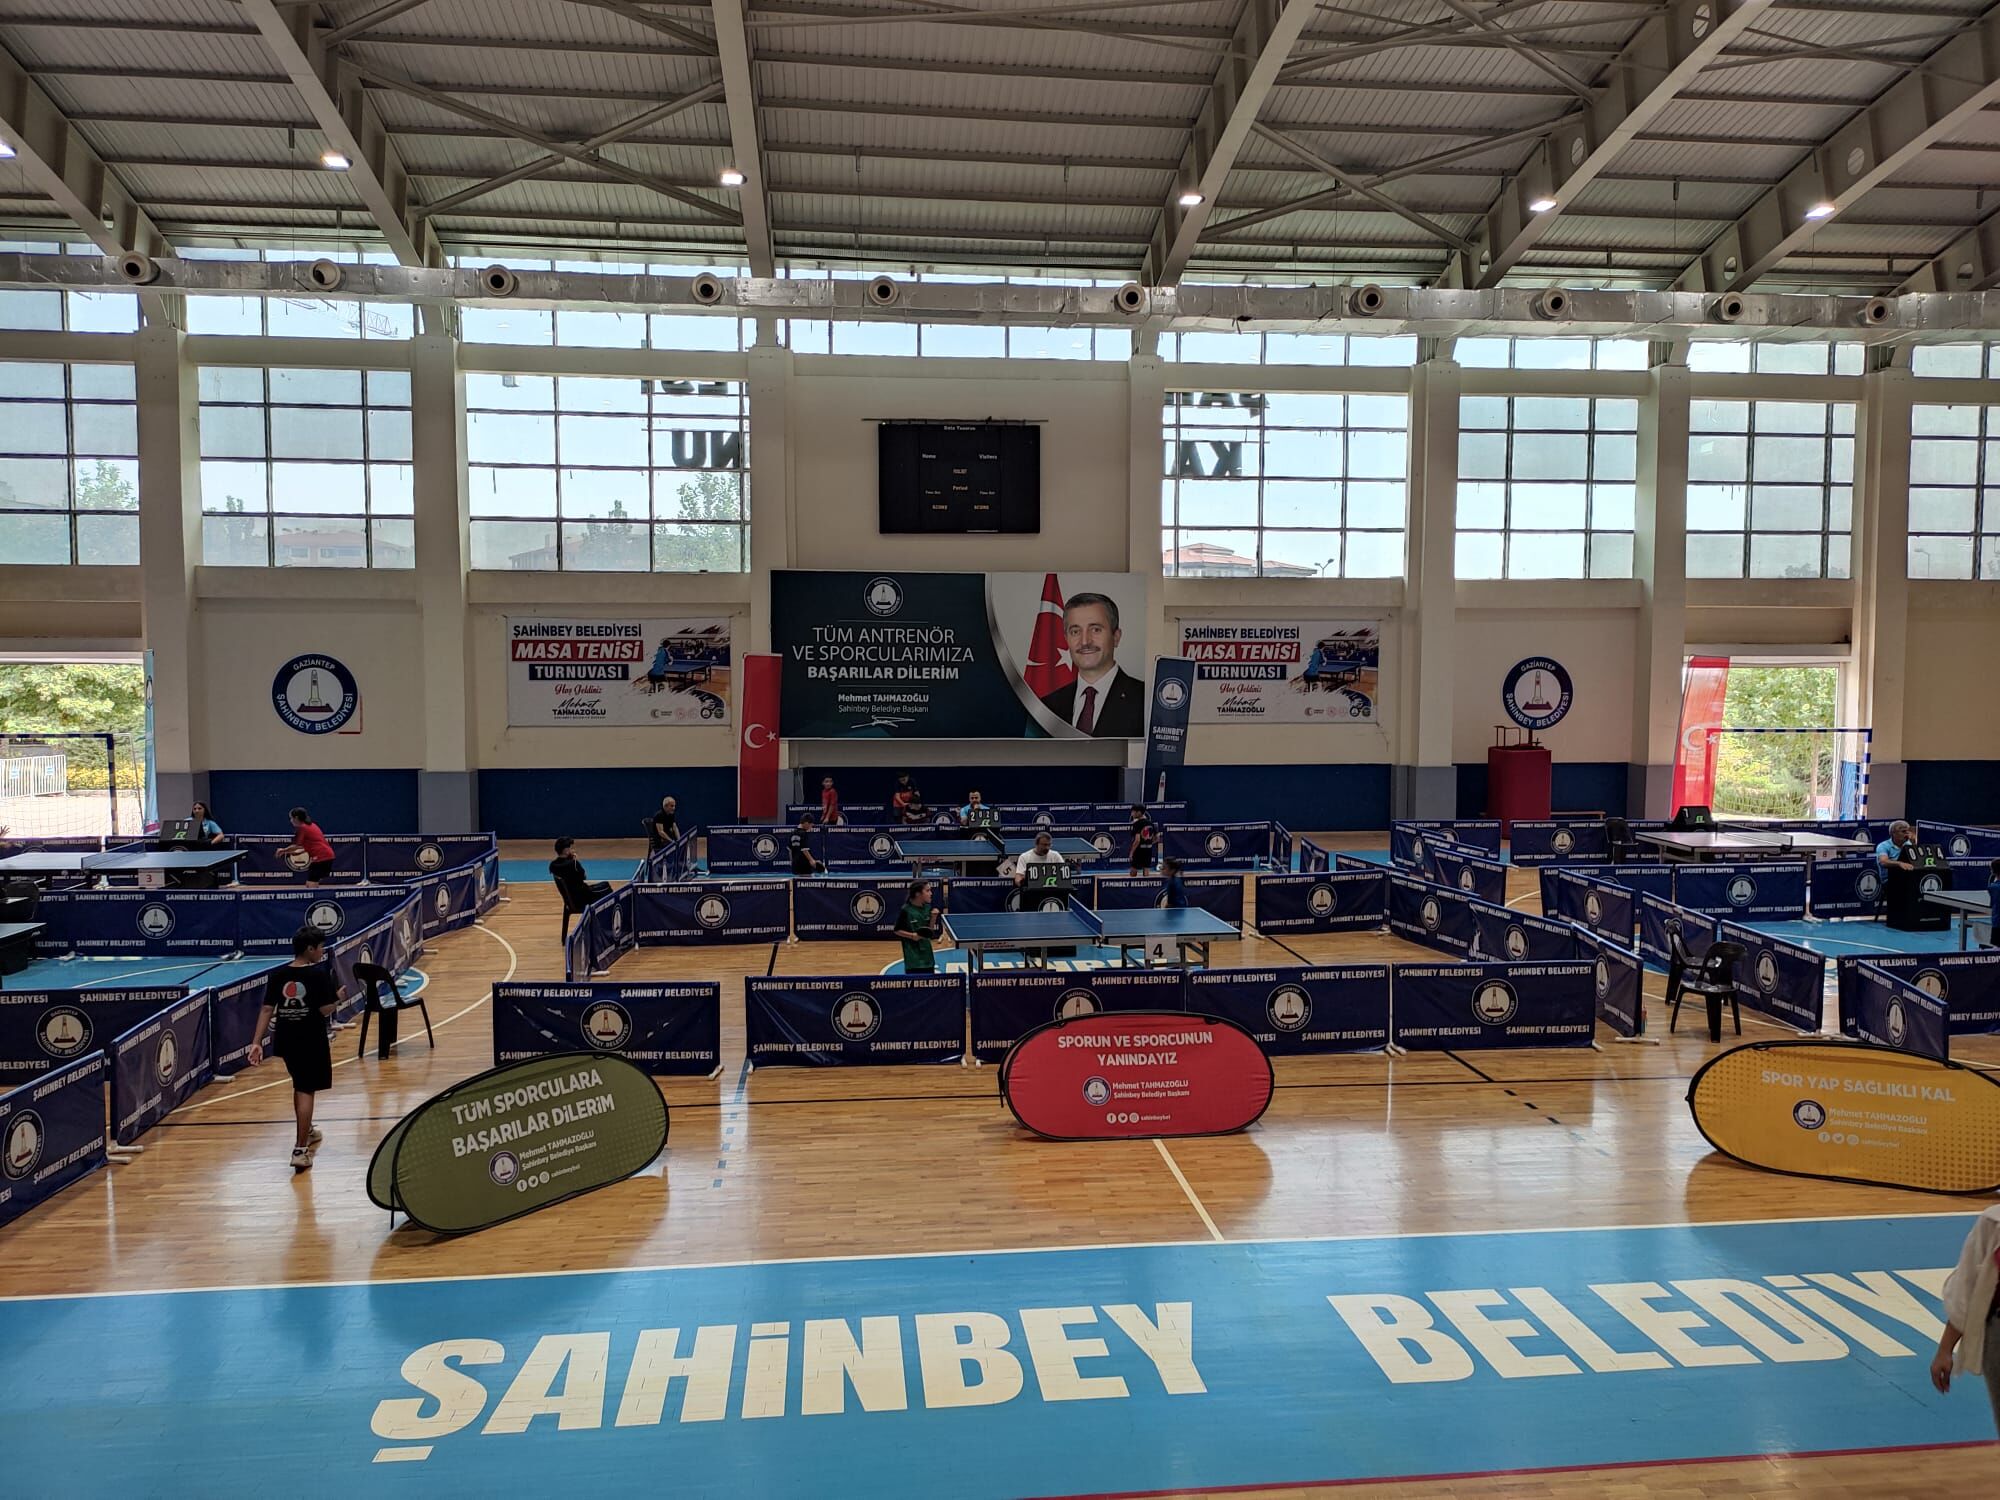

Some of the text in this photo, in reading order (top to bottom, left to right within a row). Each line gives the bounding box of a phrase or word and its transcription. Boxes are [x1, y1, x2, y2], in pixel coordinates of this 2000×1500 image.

[513, 622, 642, 638] ŞAHİNBEY BELEDİYESİ
[812, 624, 955, 645] TÜM ANTRENÖR
[1184, 625, 1300, 640] ŞAHİNBEY BELEDİYESİ
[515, 641, 641, 659] MASA TENİSİ
[792, 645, 975, 662] VE SPORCULARIMIZA
[1185, 643, 1299, 661] MASA TENİSİ
[293, 657, 336, 671] GAZİANTEP
[1520, 660, 1556, 672] GAZİANTEP
[534, 665, 623, 679] TURNUVASI
[807, 664, 959, 682] BAŞARILAR DİLERİM
[1202, 665, 1281, 679] TURNUVASI
[838, 692, 929, 703] Mehmet TAHMAZOĞLU
[277, 693, 353, 731] ŞAHİNBEY BELEDİYESİ
[838, 704, 929, 714] Şahinbey Belediye Başkanı
[1506, 691, 1569, 727] ŞAHİNBEY BELEDİYESİ
[145, 874, 153, 883] 3
[1028, 865, 1070, 880] 10 1 2 10
[1152, 943, 1164, 958] 4
[544, 987, 593, 998] BELEDİYESİ
[665, 987, 713, 998] BELEDİYESİ
[1057, 1031, 1213, 1049] SPORUN VE SPORCUNUN
[1097, 1052, 1178, 1067] YANINDAYIZ
[1112, 1079, 1189, 1090] Mehmet TAHMAZOĞLU
[1761, 1070, 1956, 1102] SPOR YAP SAĞLIKLI KAL
[451, 1067, 604, 1126] TÜM SPORCULARA
[451, 1093, 616, 1158] BAŞARILAR DİLERİM
[519, 1145, 547, 1160] Mehmet
[369, 1300, 1209, 1464] ŞAHİNBEY
